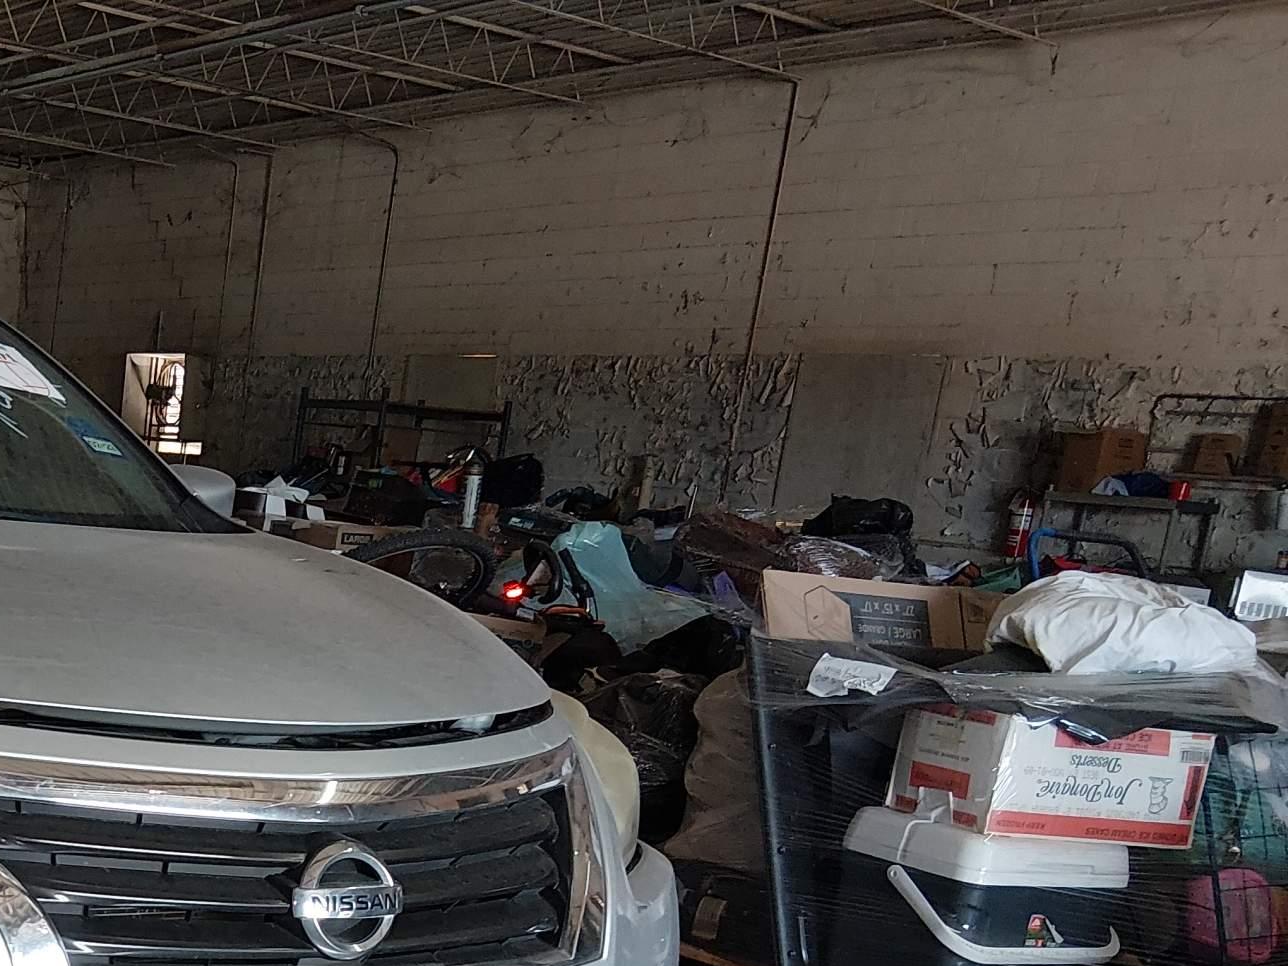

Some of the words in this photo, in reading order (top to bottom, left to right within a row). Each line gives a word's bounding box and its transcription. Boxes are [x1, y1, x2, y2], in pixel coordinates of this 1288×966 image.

[858, 624, 886, 634] GRANDE
[893, 627, 922, 640] LARGE
[1070, 754, 1122, 774] Desserts
[312, 893, 396, 914] NISSAN
